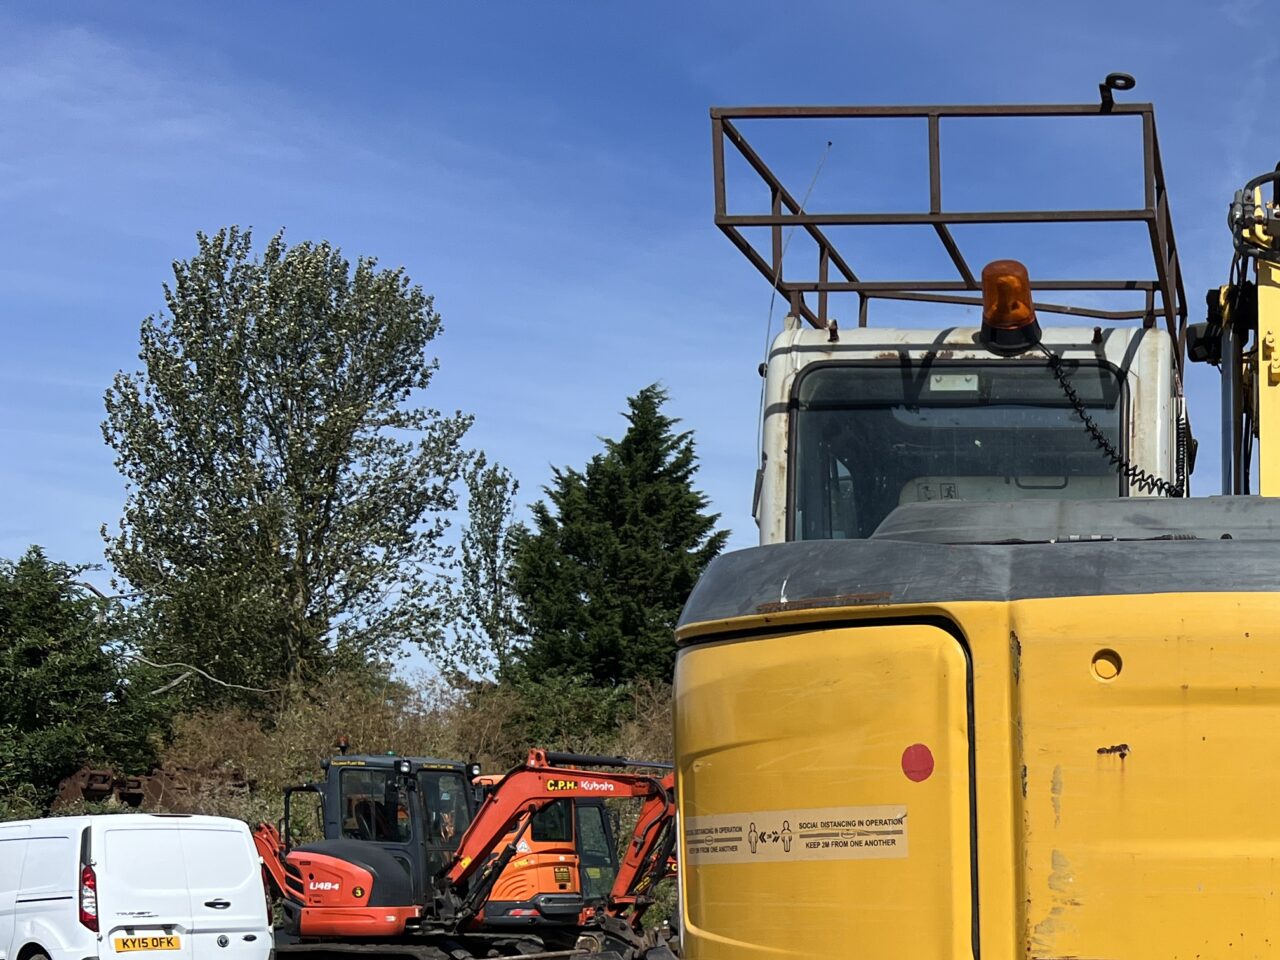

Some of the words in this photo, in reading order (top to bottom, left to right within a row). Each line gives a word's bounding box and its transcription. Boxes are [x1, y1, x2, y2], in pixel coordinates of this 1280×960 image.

[547, 780, 578, 791] C.P.H.
[581, 781, 614, 791] Kubota
[799, 821, 818, 830] SOCIAL
[820, 820, 856, 829] DISTANCING
[857, 819, 864, 827] IN
[865, 817, 903, 826] OPERATION
[805, 841, 820, 849] KEEP
[831, 840, 848, 848] FROM
[864, 838, 896, 847] ANOTHER
[310, 882, 339, 891] U48-4
[122, 937, 149, 949] KY15
[152, 936, 174, 948] OFK
